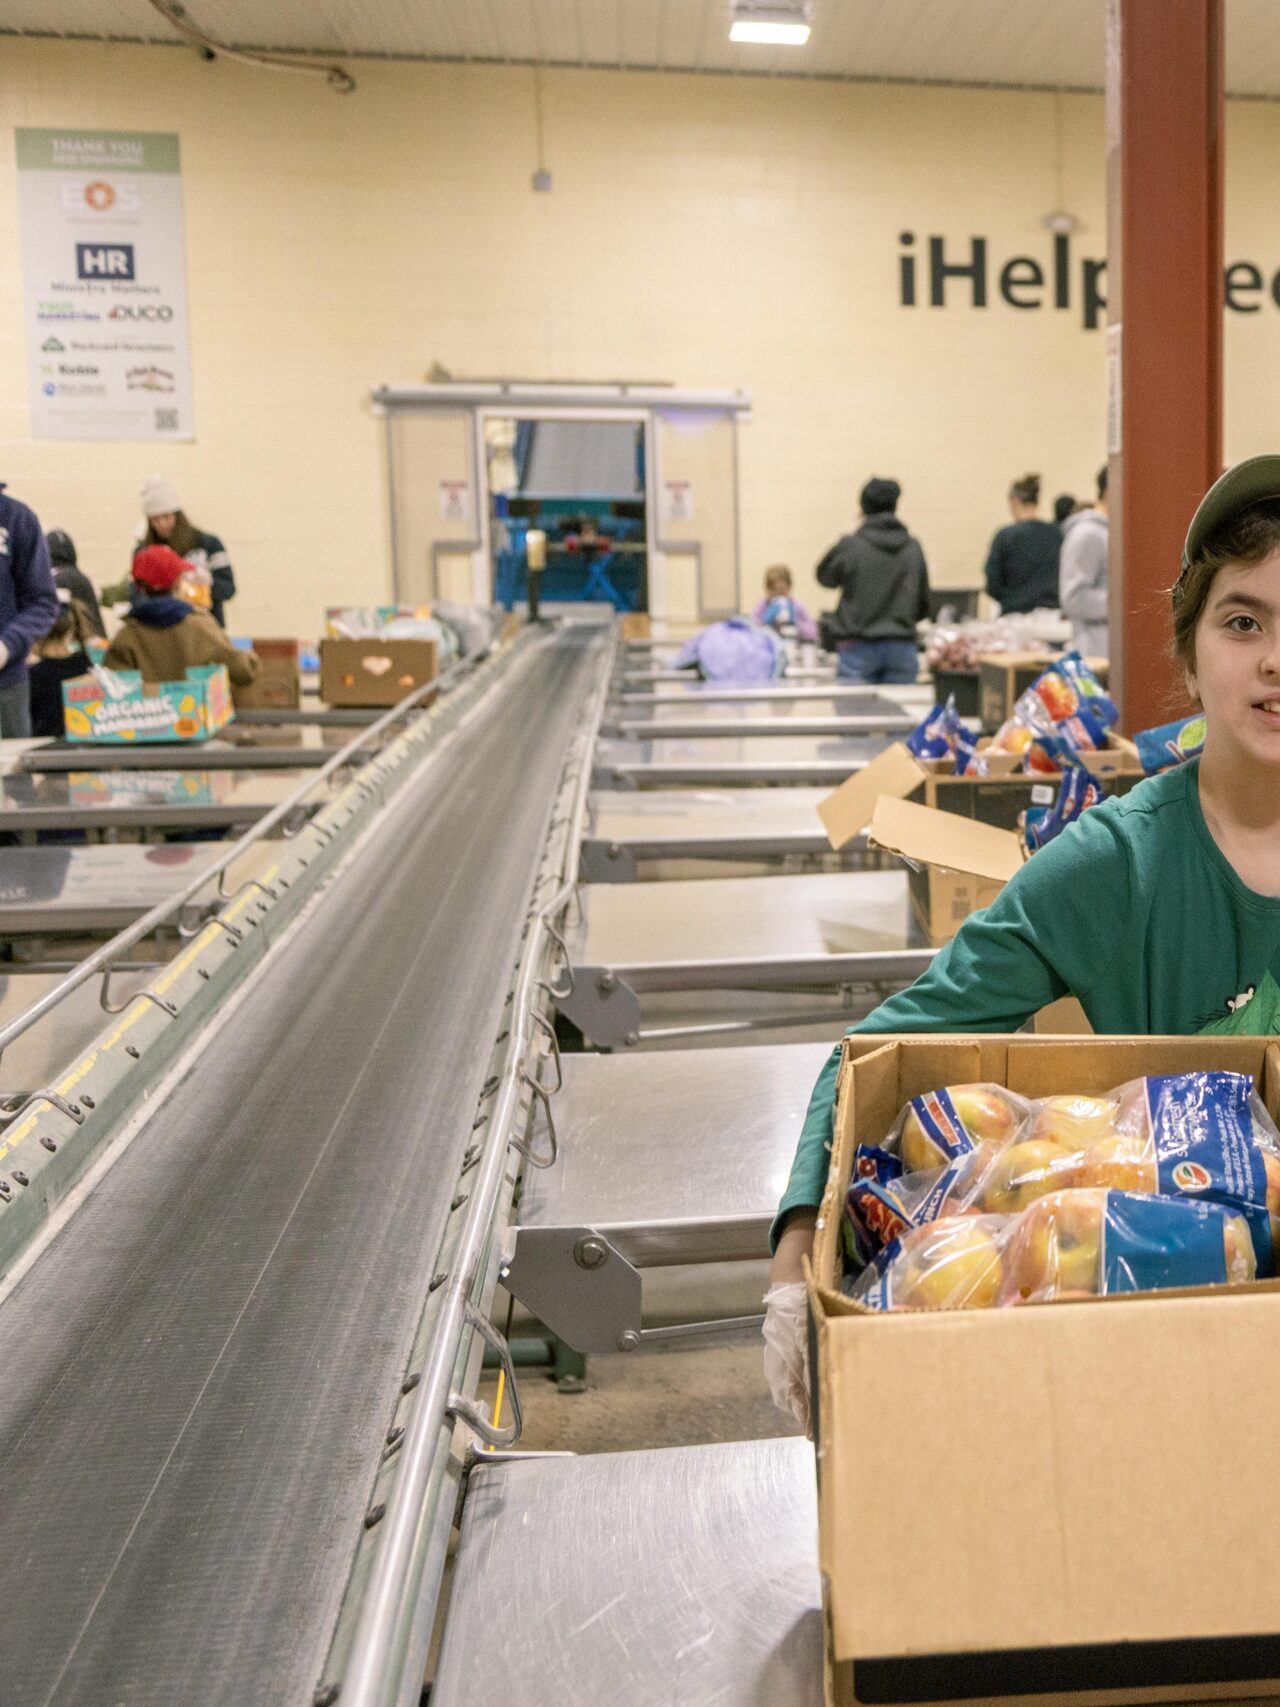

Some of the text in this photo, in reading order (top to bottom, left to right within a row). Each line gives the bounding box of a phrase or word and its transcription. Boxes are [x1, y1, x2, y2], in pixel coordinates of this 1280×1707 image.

[83, 248, 130, 276] HR
[897, 231, 1109, 331] iHelp
[94, 695, 173, 722] ORGANIC
